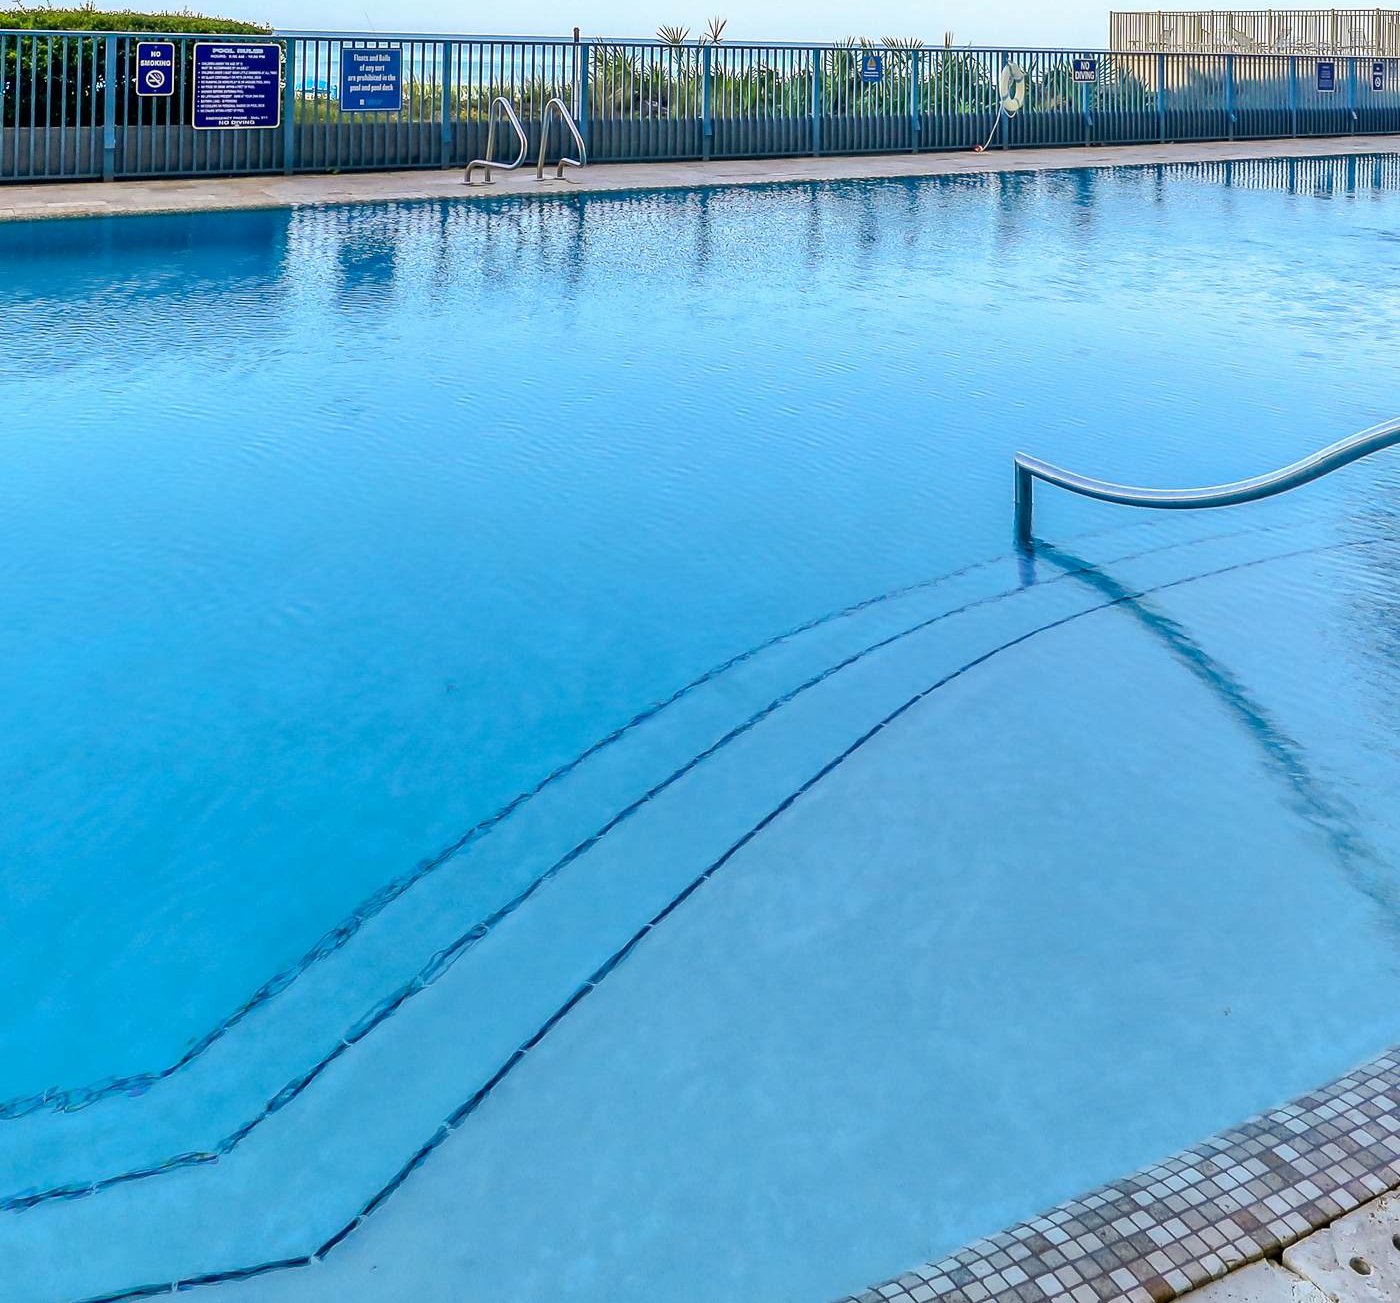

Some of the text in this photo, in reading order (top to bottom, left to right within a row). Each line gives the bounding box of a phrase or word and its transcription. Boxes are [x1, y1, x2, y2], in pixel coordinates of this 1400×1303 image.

[365, 65, 374, 73] any
[1080, 61, 1090, 70] NO
[357, 74, 381, 82] prohibited
[1075, 70, 1095, 80] DIVING
[350, 84, 360, 93] pool
[371, 84, 381, 92] pool
